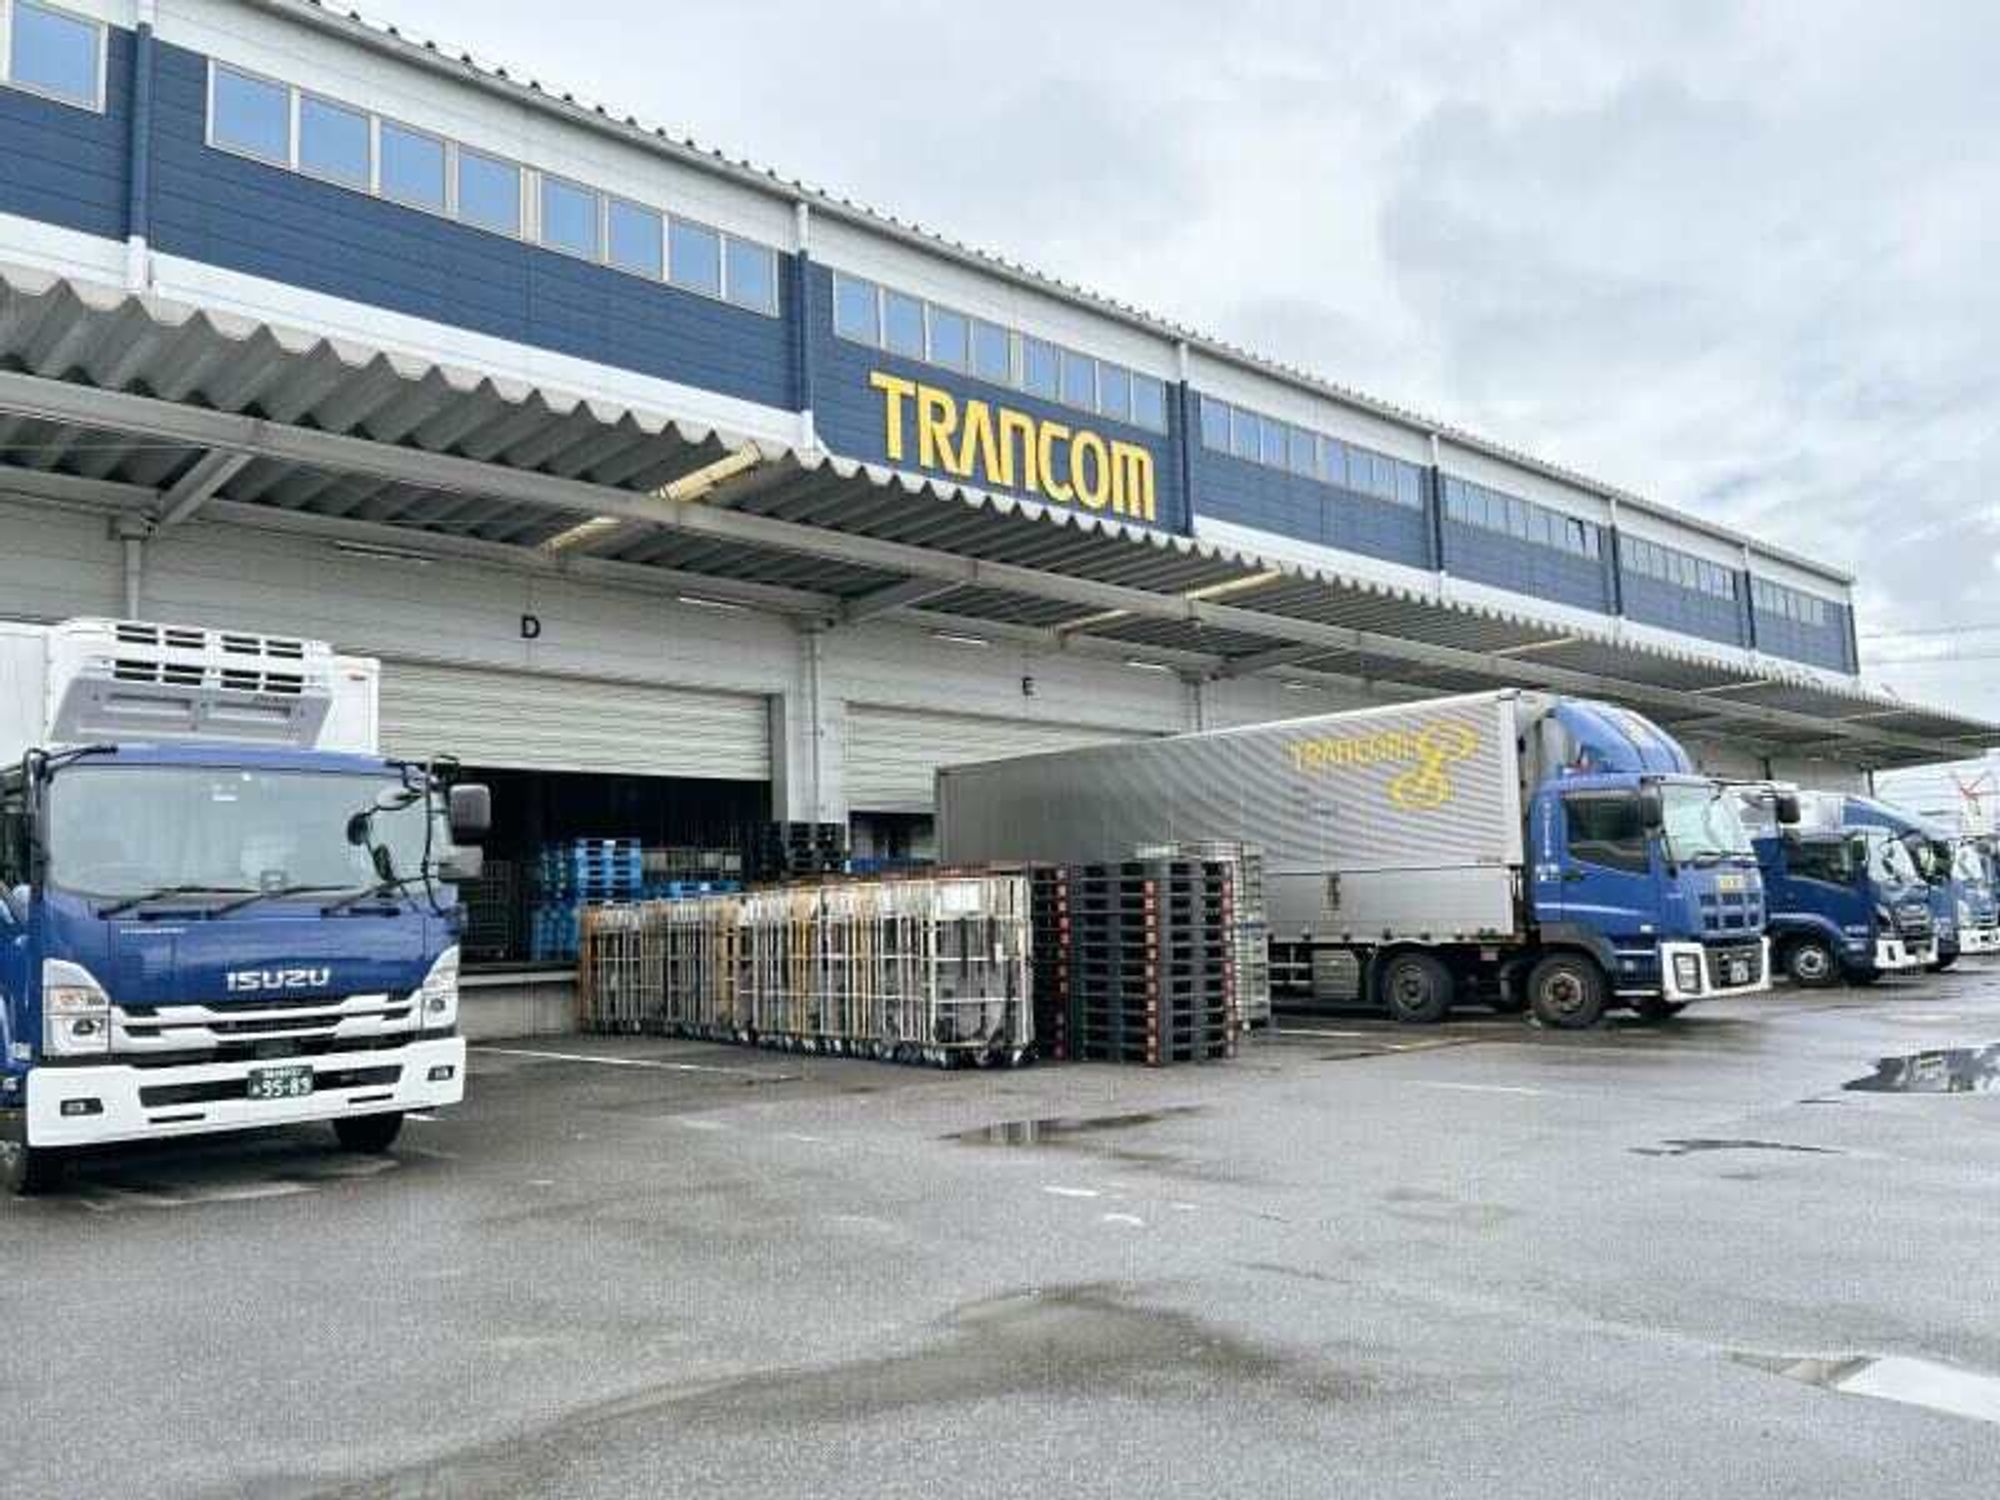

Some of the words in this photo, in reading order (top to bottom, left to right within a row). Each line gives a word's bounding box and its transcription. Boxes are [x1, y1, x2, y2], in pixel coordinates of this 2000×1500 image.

[869, 371, 1155, 521] TRANCOM
[521, 614, 541, 639] D
[1022, 676, 1034, 696] E
[227, 967, 331, 991] ISUZU
